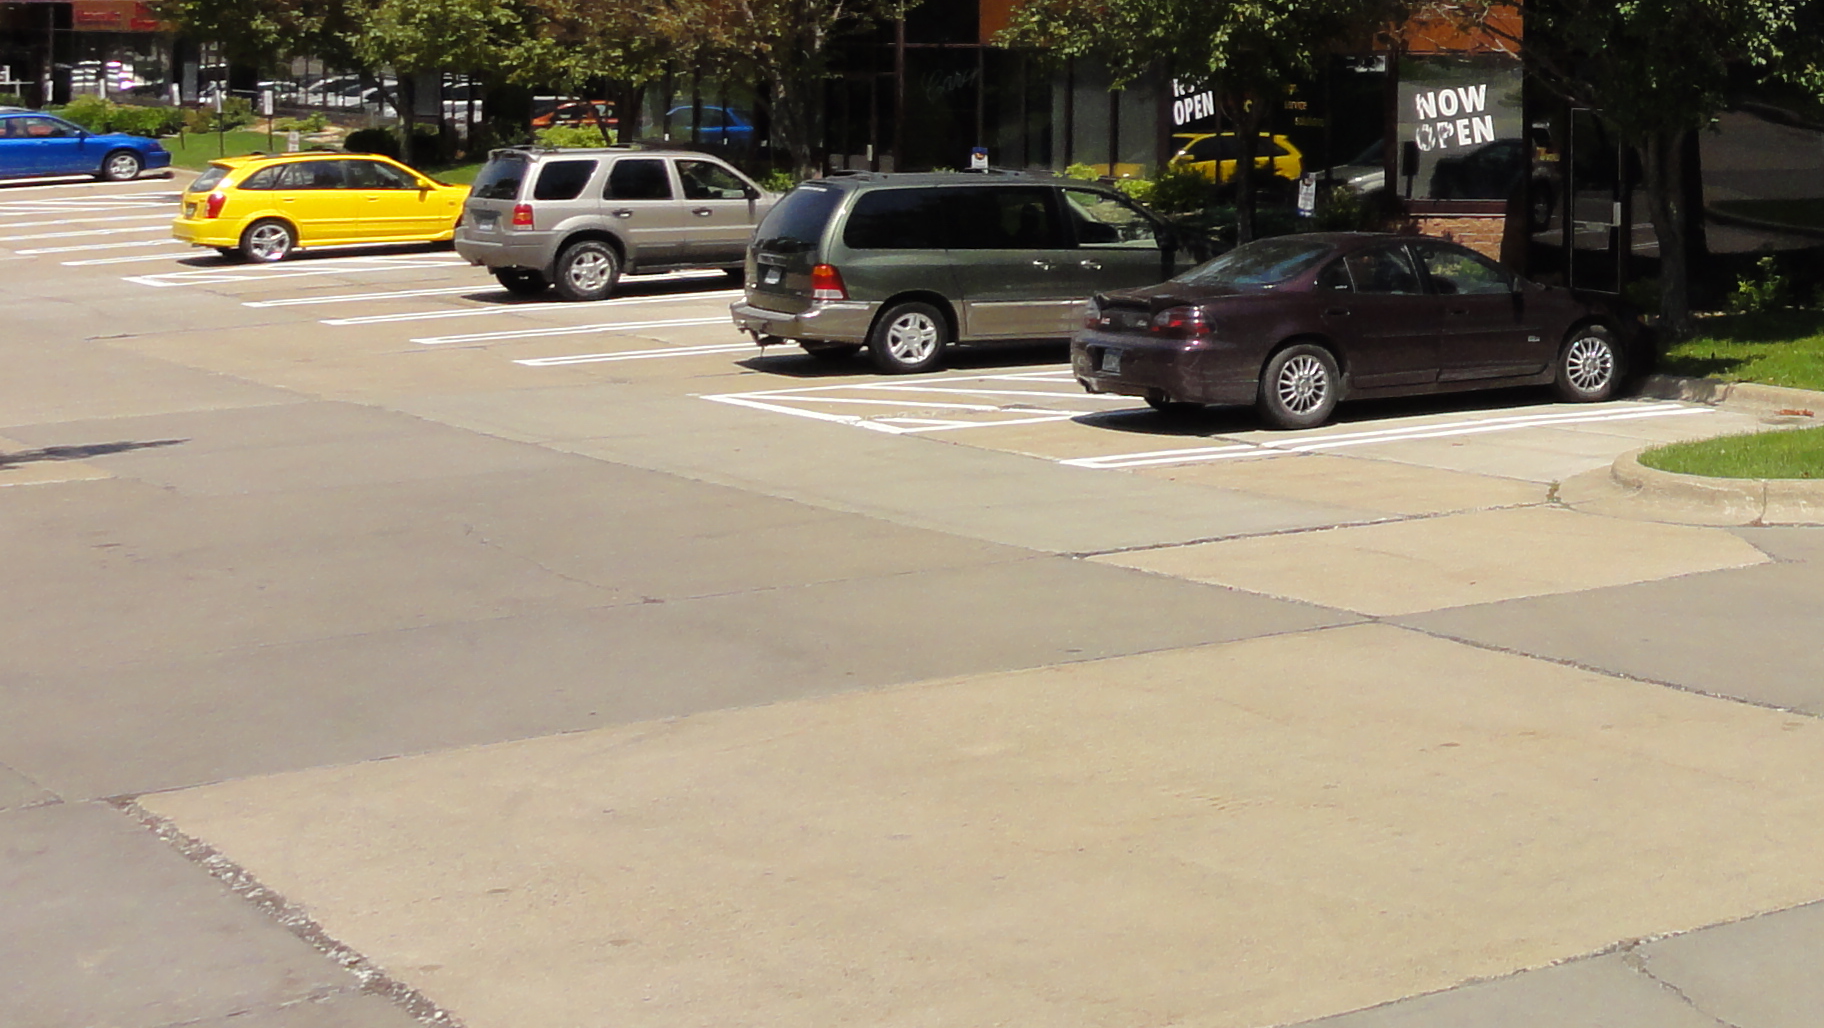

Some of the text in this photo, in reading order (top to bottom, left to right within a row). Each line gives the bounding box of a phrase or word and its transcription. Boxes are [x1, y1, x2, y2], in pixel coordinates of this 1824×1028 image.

[1173, 90, 1215, 126] OPEN
[1415, 84, 1487, 120] NOW
[1415, 114, 1495, 152] OPEN
